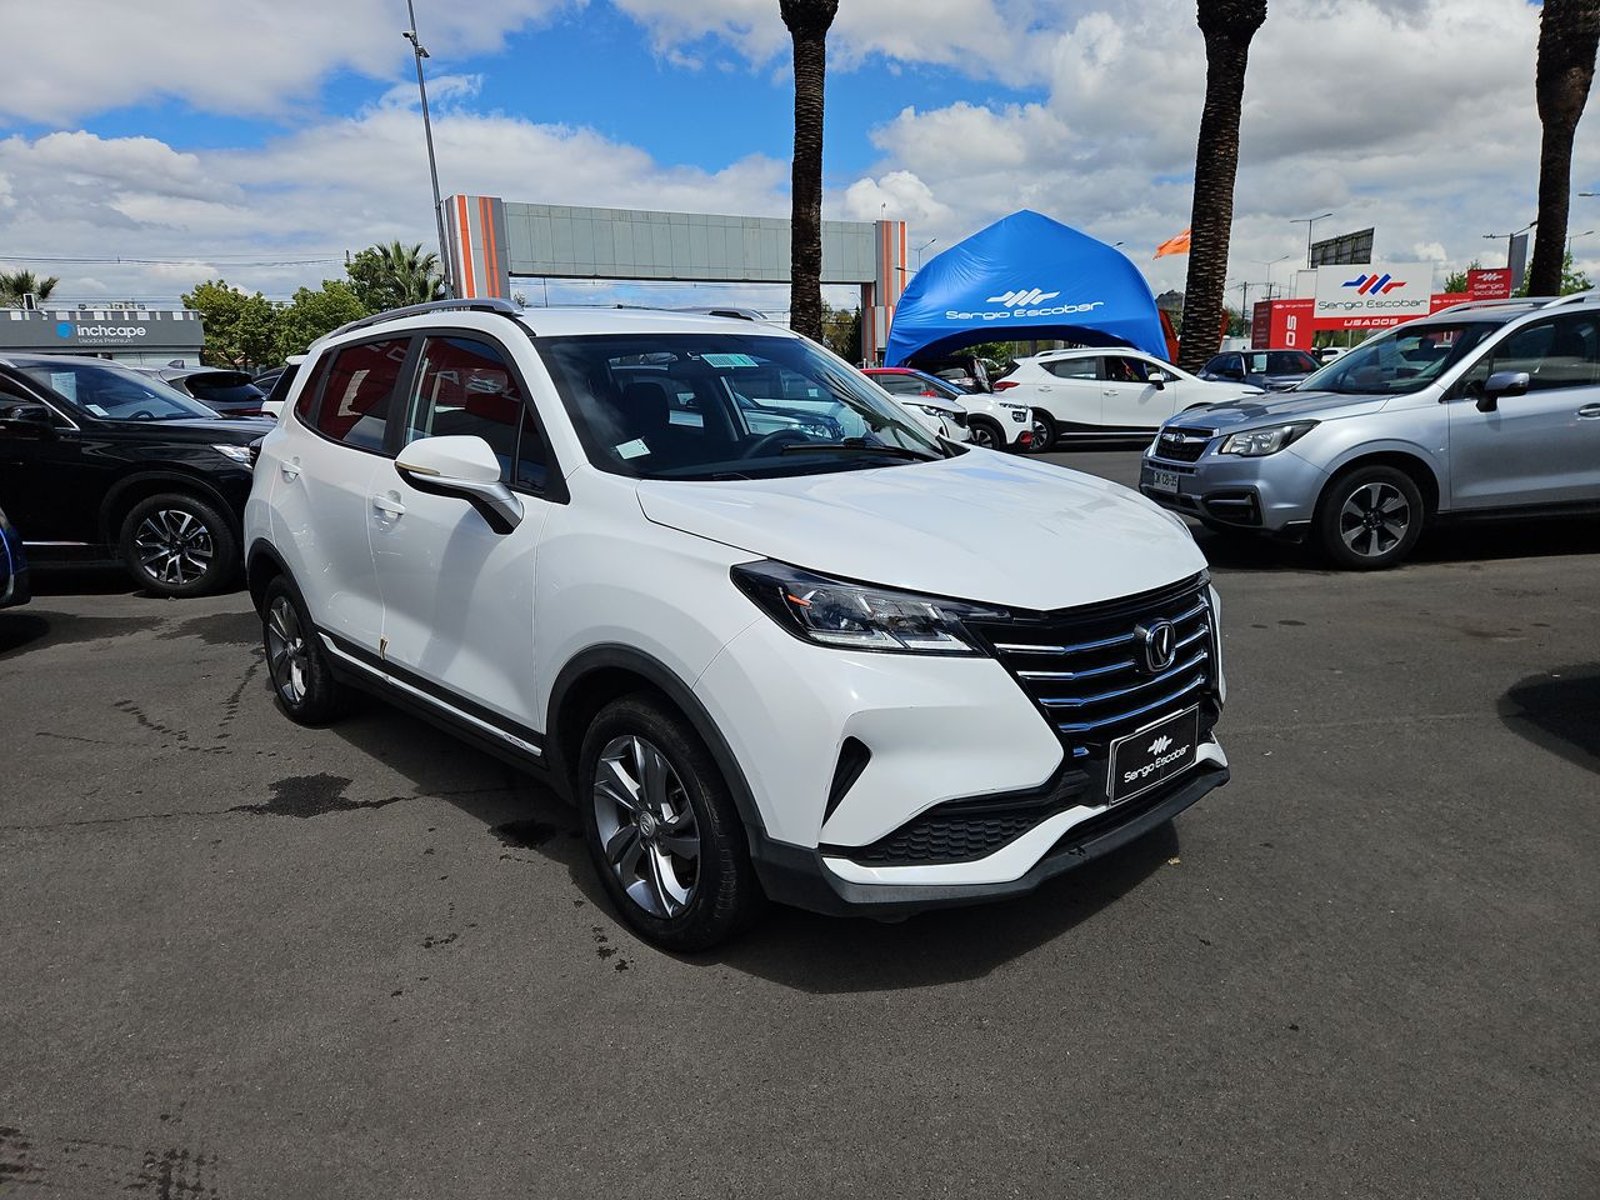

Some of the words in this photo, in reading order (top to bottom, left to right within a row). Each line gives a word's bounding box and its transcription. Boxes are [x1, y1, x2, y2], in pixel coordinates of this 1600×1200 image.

[1014, 301, 1105, 317] Escobar
[1366, 299, 1427, 308] Escobar
[1343, 318, 1399, 326] USADOS
[76, 324, 146, 338] inchcape
[1155, 744, 1190, 769] Escobar
